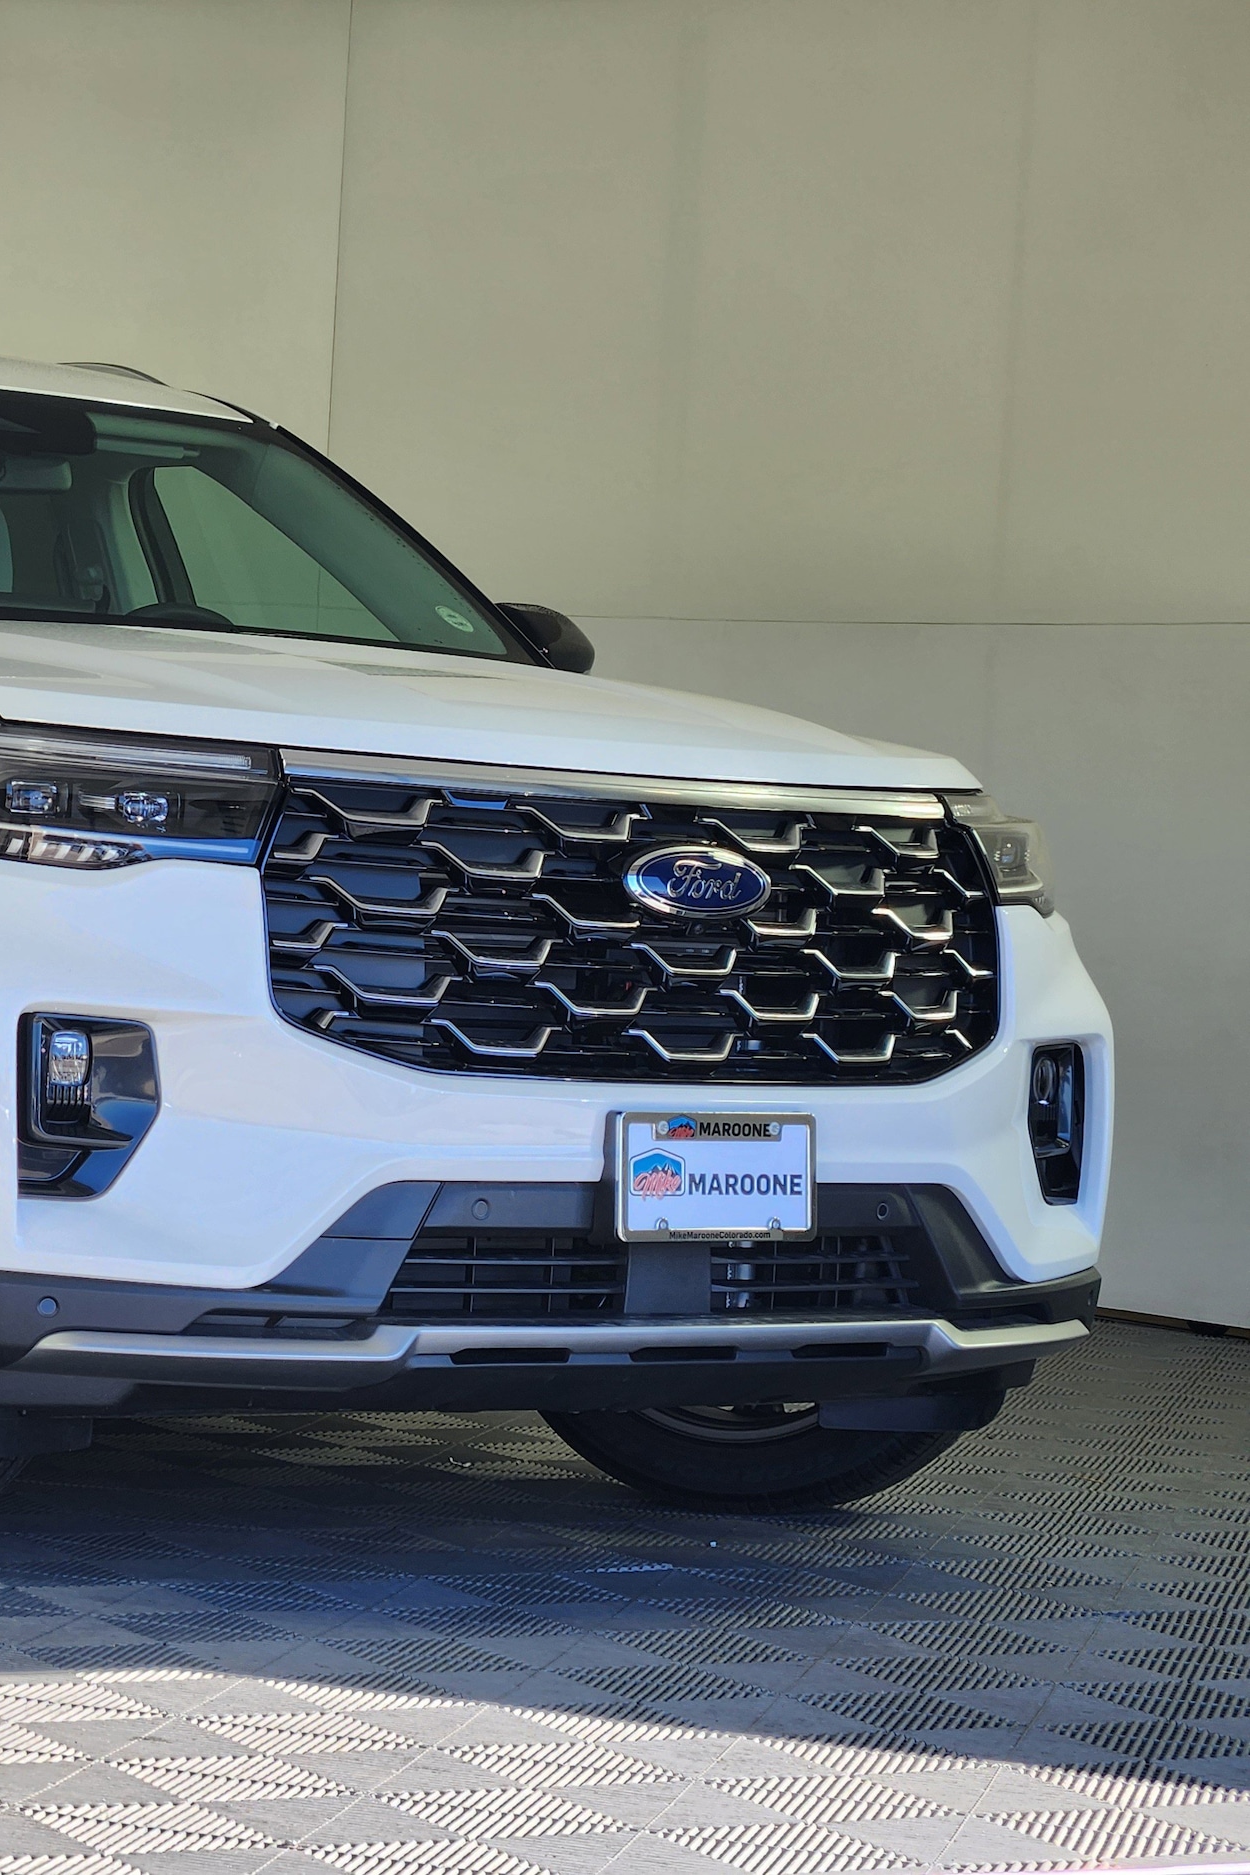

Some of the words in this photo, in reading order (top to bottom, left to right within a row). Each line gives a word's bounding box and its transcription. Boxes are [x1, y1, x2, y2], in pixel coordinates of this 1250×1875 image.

[666, 859, 742, 900] Ford
[699, 1122, 771, 1138] MAROONE
[633, 1169, 682, 1201] Mike
[688, 1173, 803, 1196] MAROONE
[669, 1231, 771, 1239] MikeMarooneColorado.com
